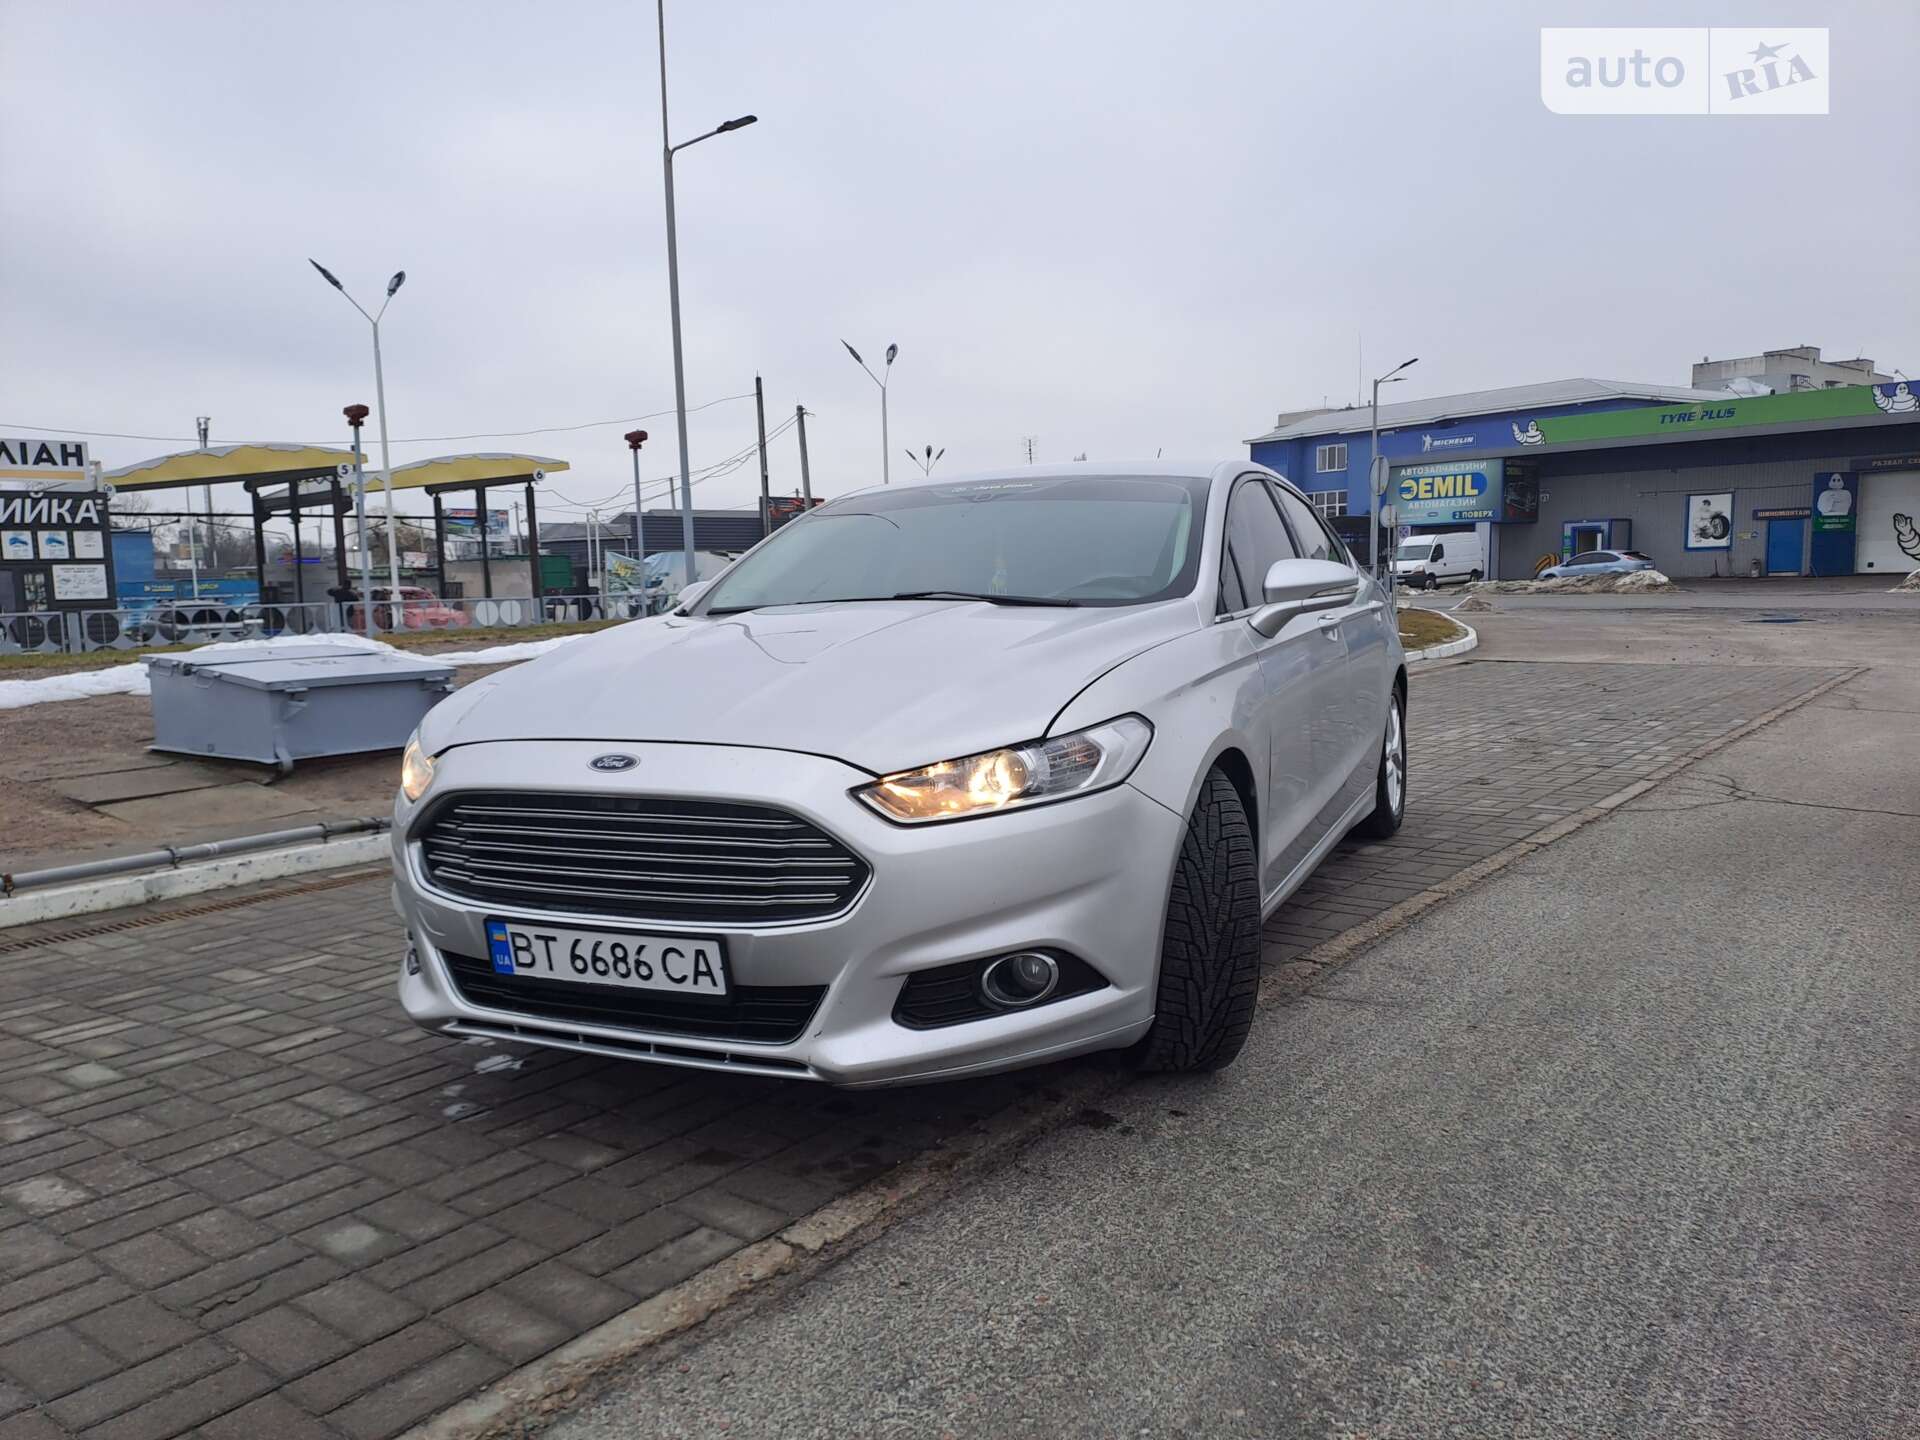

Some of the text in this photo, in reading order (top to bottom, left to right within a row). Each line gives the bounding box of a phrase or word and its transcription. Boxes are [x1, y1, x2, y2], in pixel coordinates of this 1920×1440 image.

[1660, 408, 1736, 424] TYRE PLUS
[1432, 436, 1474, 446] MICHELIN
[341, 464, 349, 475] 5
[536, 470, 543, 480] 6
[1399, 461, 1488, 477] АВТОЗАПЧАСТИНИ
[1407, 498, 1477, 511] АВТОМАГАЗИН
[1462, 510, 1494, 519] ПОВЕРХ
[496, 953, 512, 967] UA
[509, 931, 719, 988] BT 6686 CA
